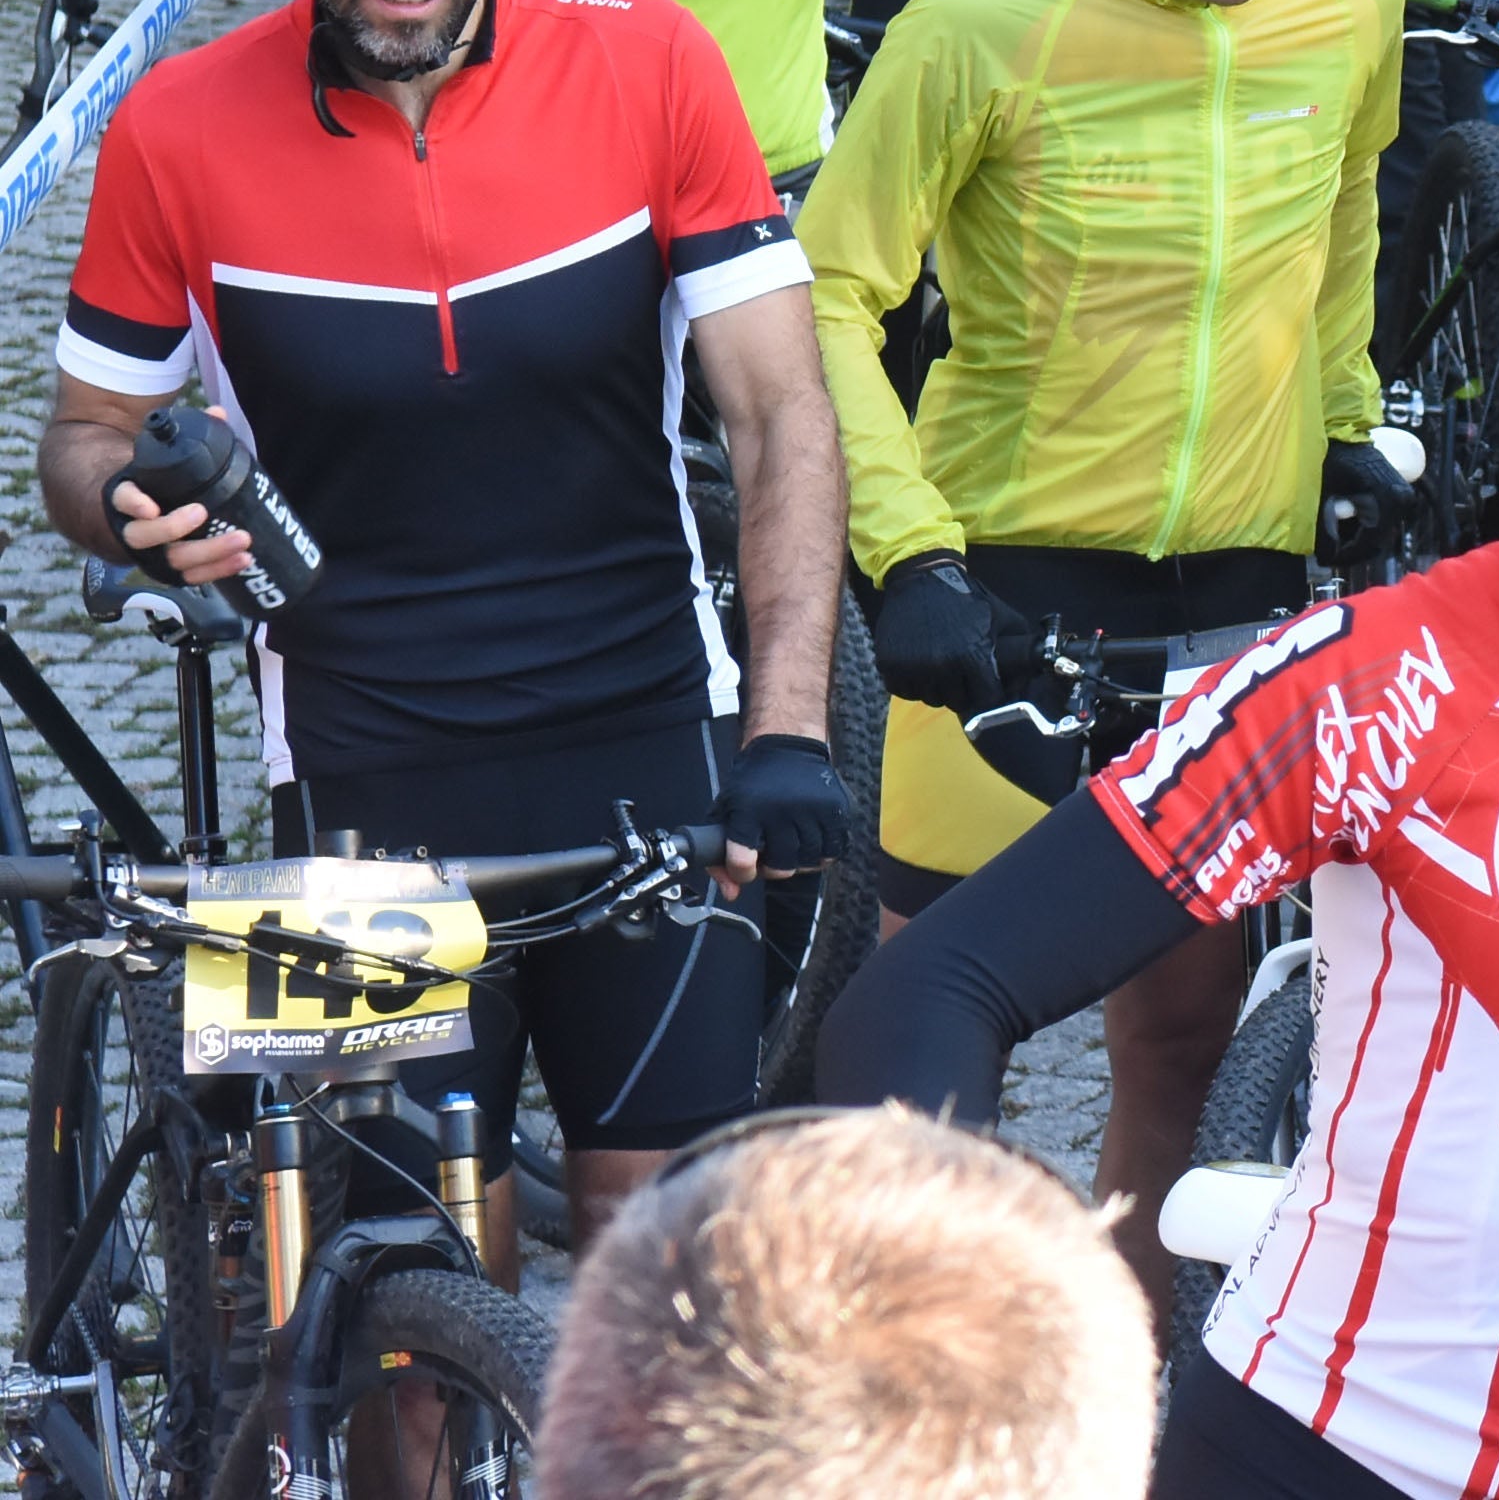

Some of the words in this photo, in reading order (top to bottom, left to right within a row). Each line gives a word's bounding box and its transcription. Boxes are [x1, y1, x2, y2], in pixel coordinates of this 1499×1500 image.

[264, 492, 322, 571] CRAFT
[231, 1028, 326, 1057] sopharma
[341, 1012, 457, 1046] DRAG
